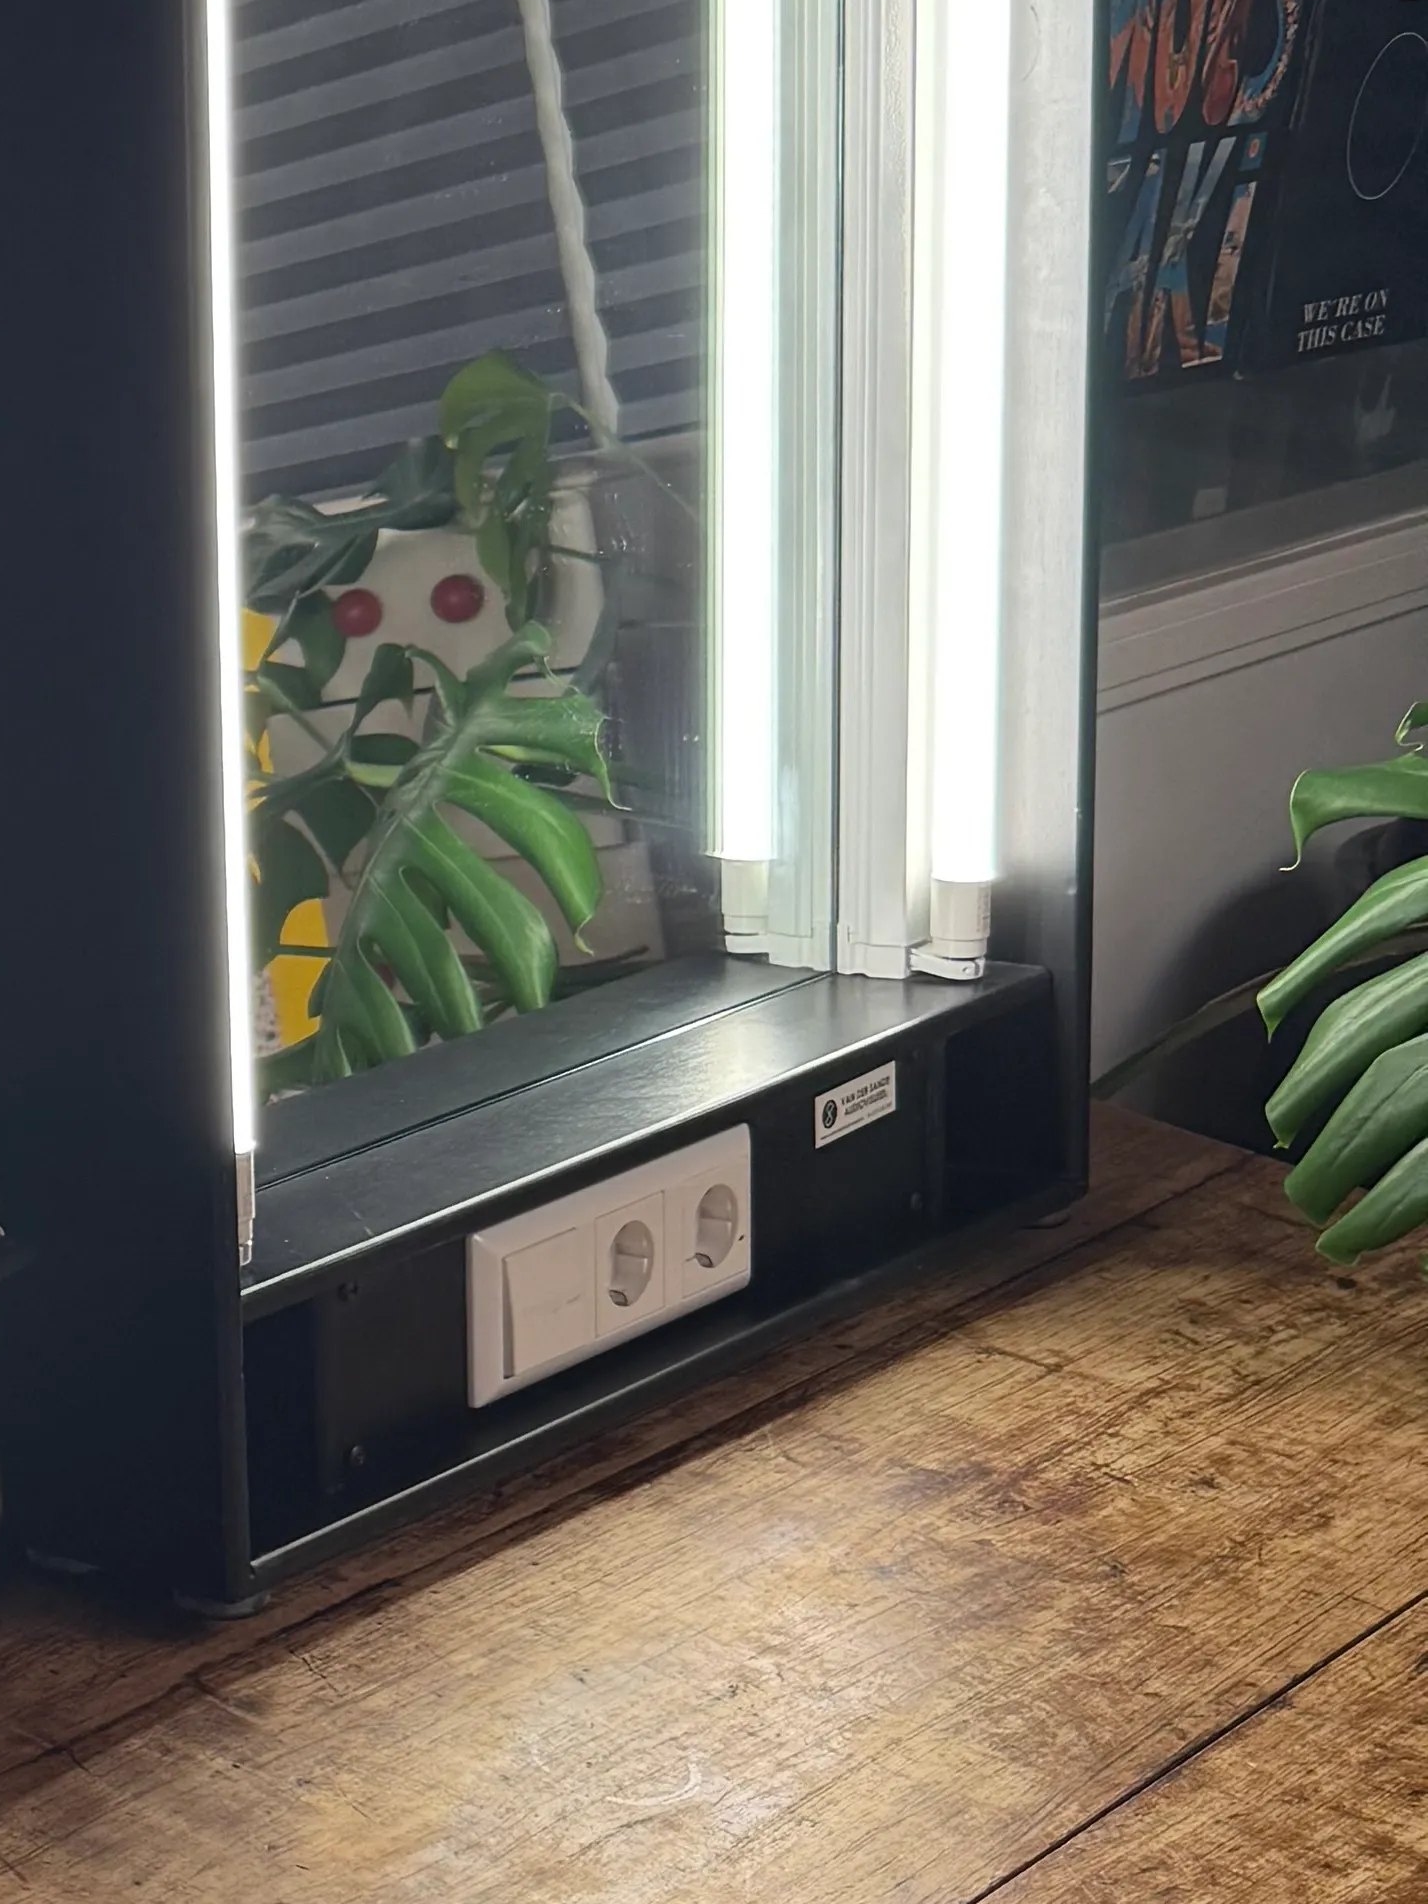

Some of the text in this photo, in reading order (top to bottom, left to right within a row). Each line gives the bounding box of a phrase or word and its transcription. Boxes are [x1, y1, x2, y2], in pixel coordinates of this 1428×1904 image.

[1302, 287, 1389, 325] WE'RE ON
[1296, 314, 1387, 354] THIS CASE
